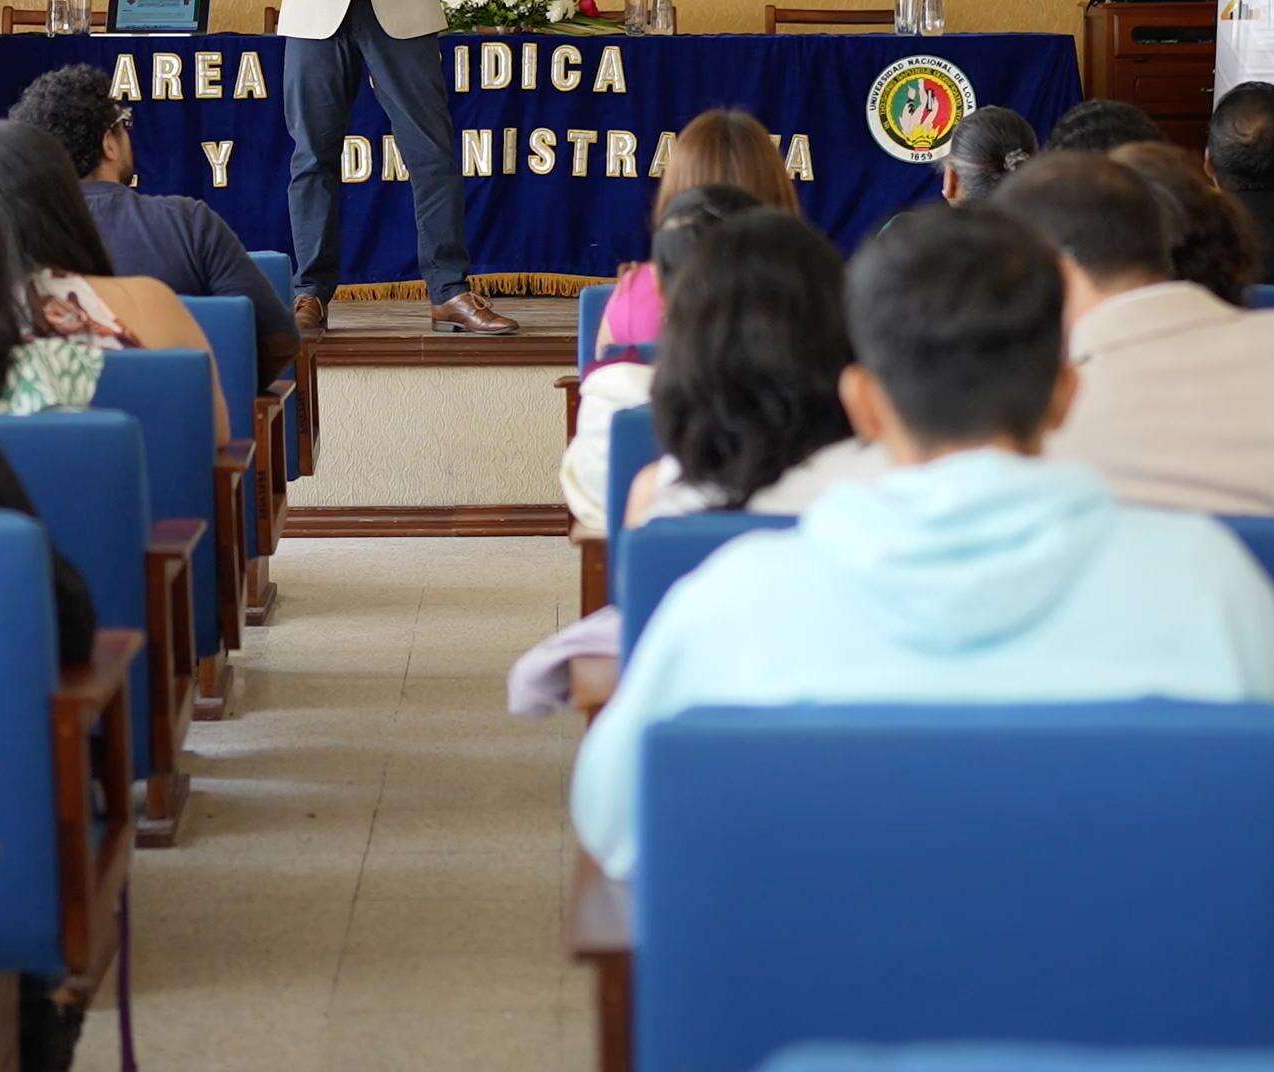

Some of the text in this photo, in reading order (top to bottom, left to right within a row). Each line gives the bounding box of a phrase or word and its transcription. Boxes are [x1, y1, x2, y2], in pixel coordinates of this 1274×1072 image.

[108, 51, 268, 101] AREA
[870, 63, 904, 110] UNIVERSIDAD
[908, 58, 952, 72] NACIONAL
[954, 73, 965, 84] DE
[963, 86, 973, 110] LOJA
[201, 140, 233, 187] Y
